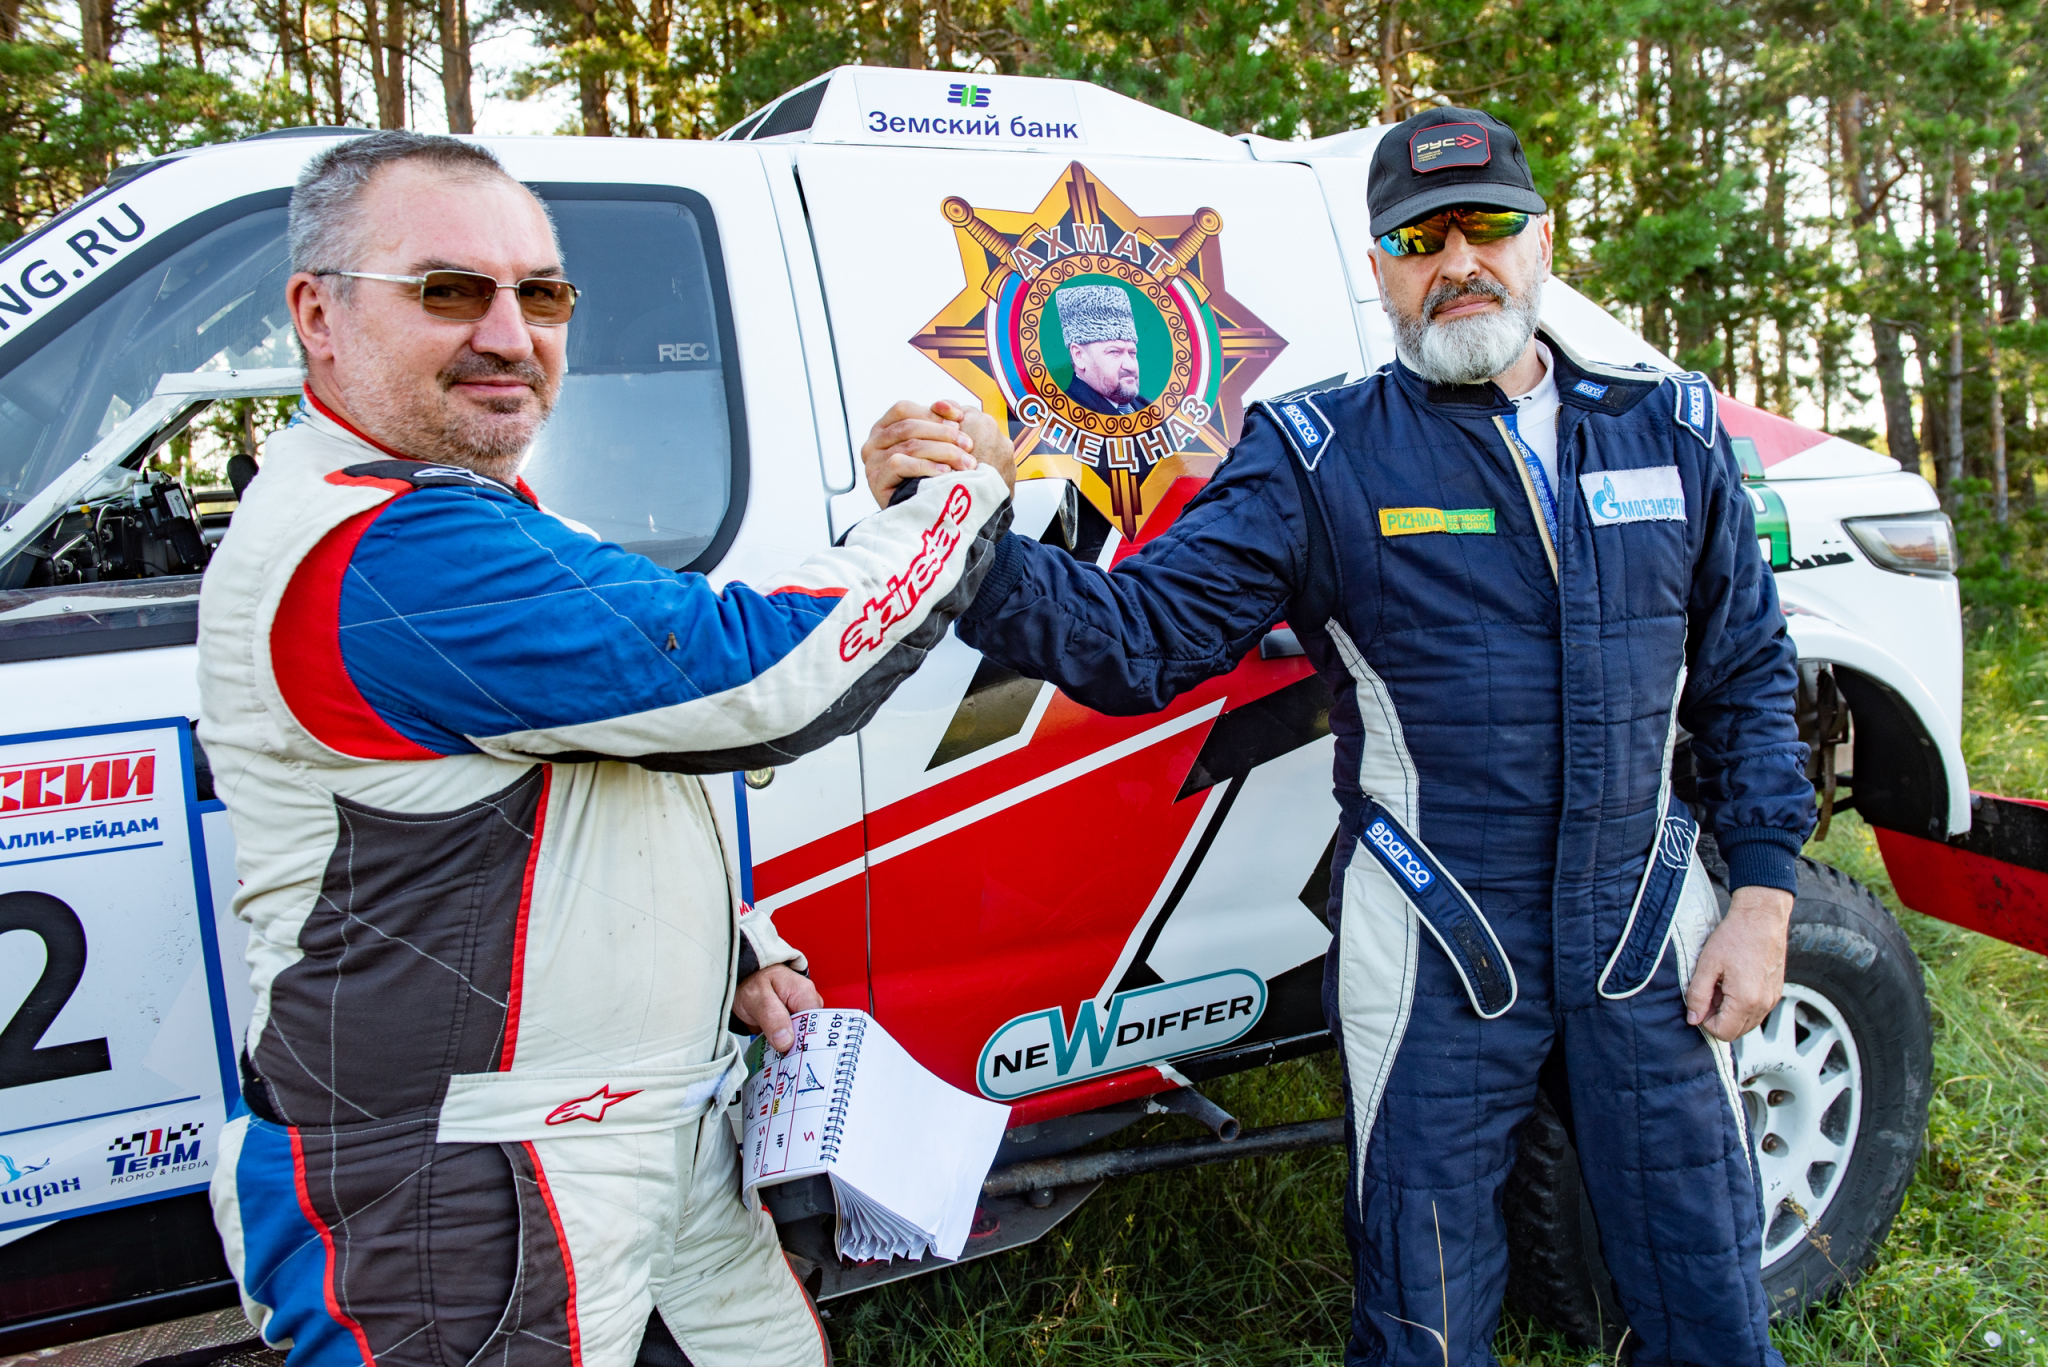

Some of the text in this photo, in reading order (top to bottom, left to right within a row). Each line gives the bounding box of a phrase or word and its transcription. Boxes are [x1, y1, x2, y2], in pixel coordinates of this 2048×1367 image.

[868, 111, 1079, 140] Земский банк
[1010, 223, 1177, 282] АХМАТ
[1014, 393, 1213, 473] СПЕЦНАЗ
[1283, 404, 1319, 445] sparco
[1387, 513, 1444, 530] PIZHMA
[1446, 513, 1489, 523] transport
[1447, 521, 1490, 531] company
[1369, 821, 1431, 888] sparco
[0, 890, 112, 1090] 2
[808, 1013, 818, 1033] 0,93
[826, 1013, 843, 1048] 49,04
[106, 1140, 201, 1177] TEAM
[110, 1160, 210, 1186] PROMO & MEDIA
